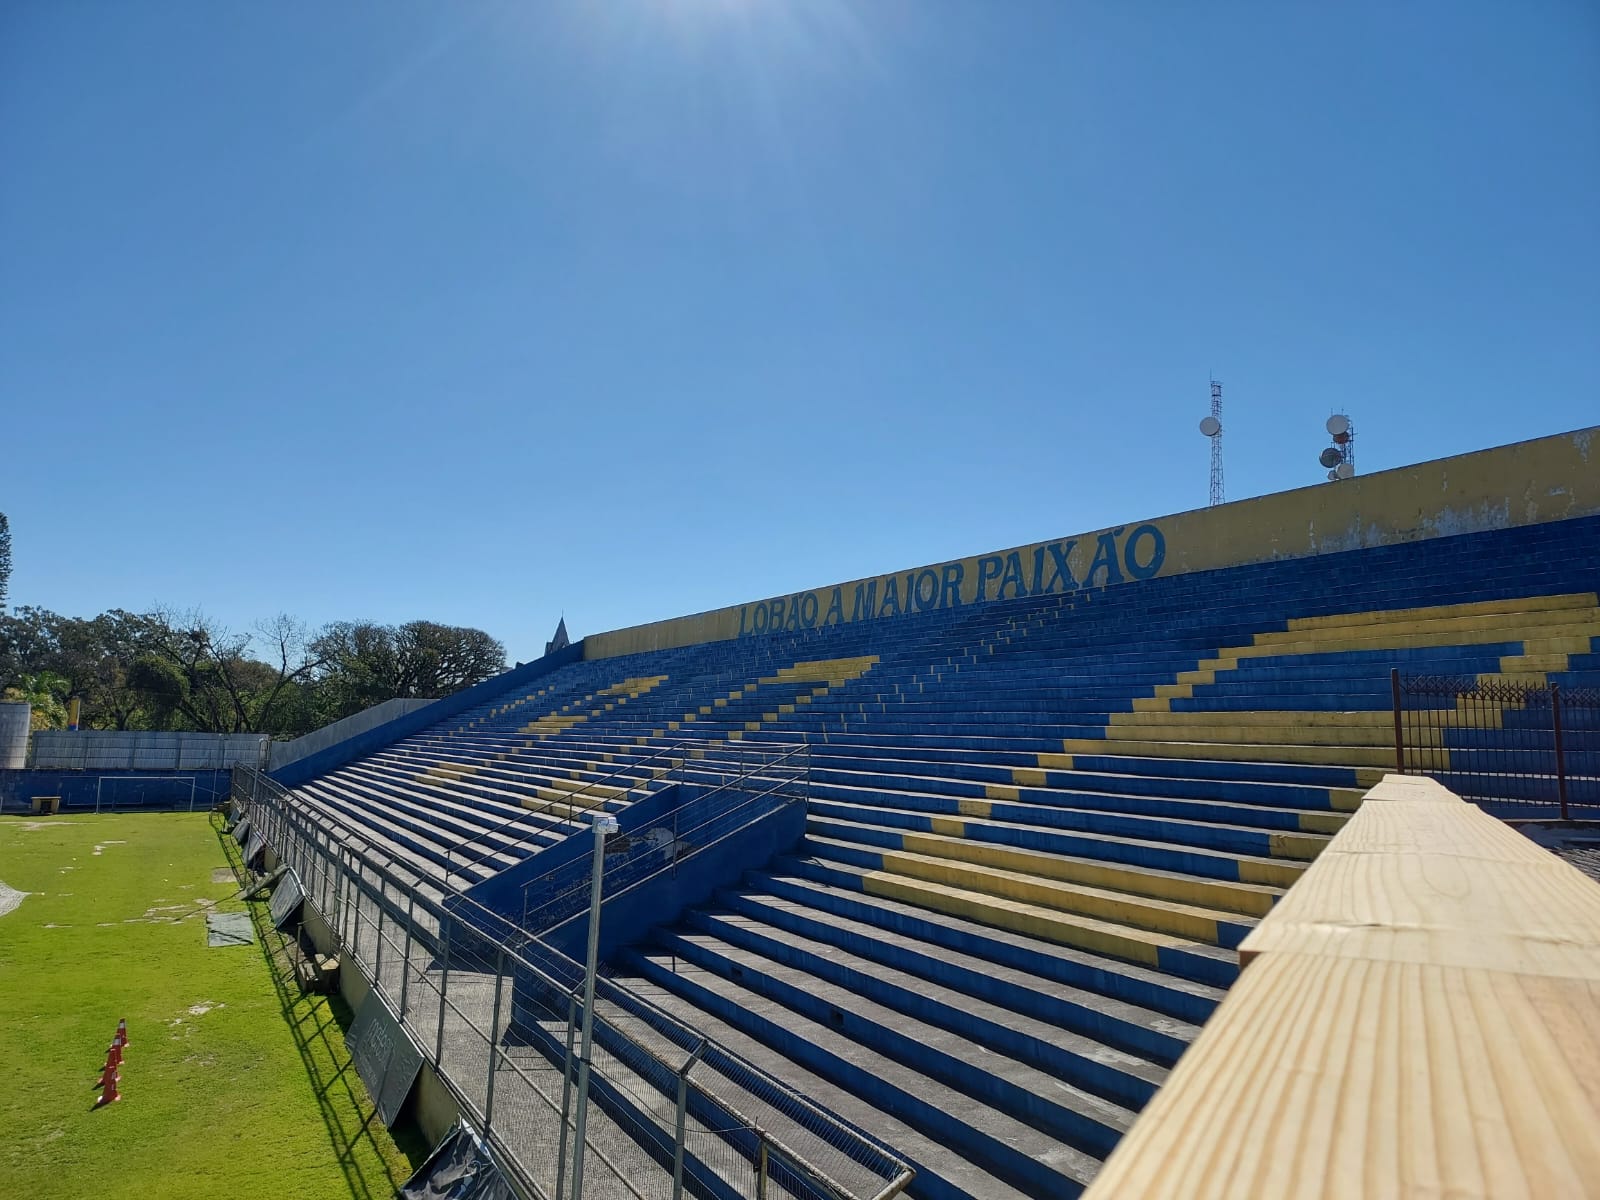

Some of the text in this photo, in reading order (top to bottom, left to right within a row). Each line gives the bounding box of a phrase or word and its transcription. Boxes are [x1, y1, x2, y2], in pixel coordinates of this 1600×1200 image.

[823, 587, 844, 625] A
[852, 564, 964, 623] MAIOR
[976, 525, 1166, 601] PAIXÃO
